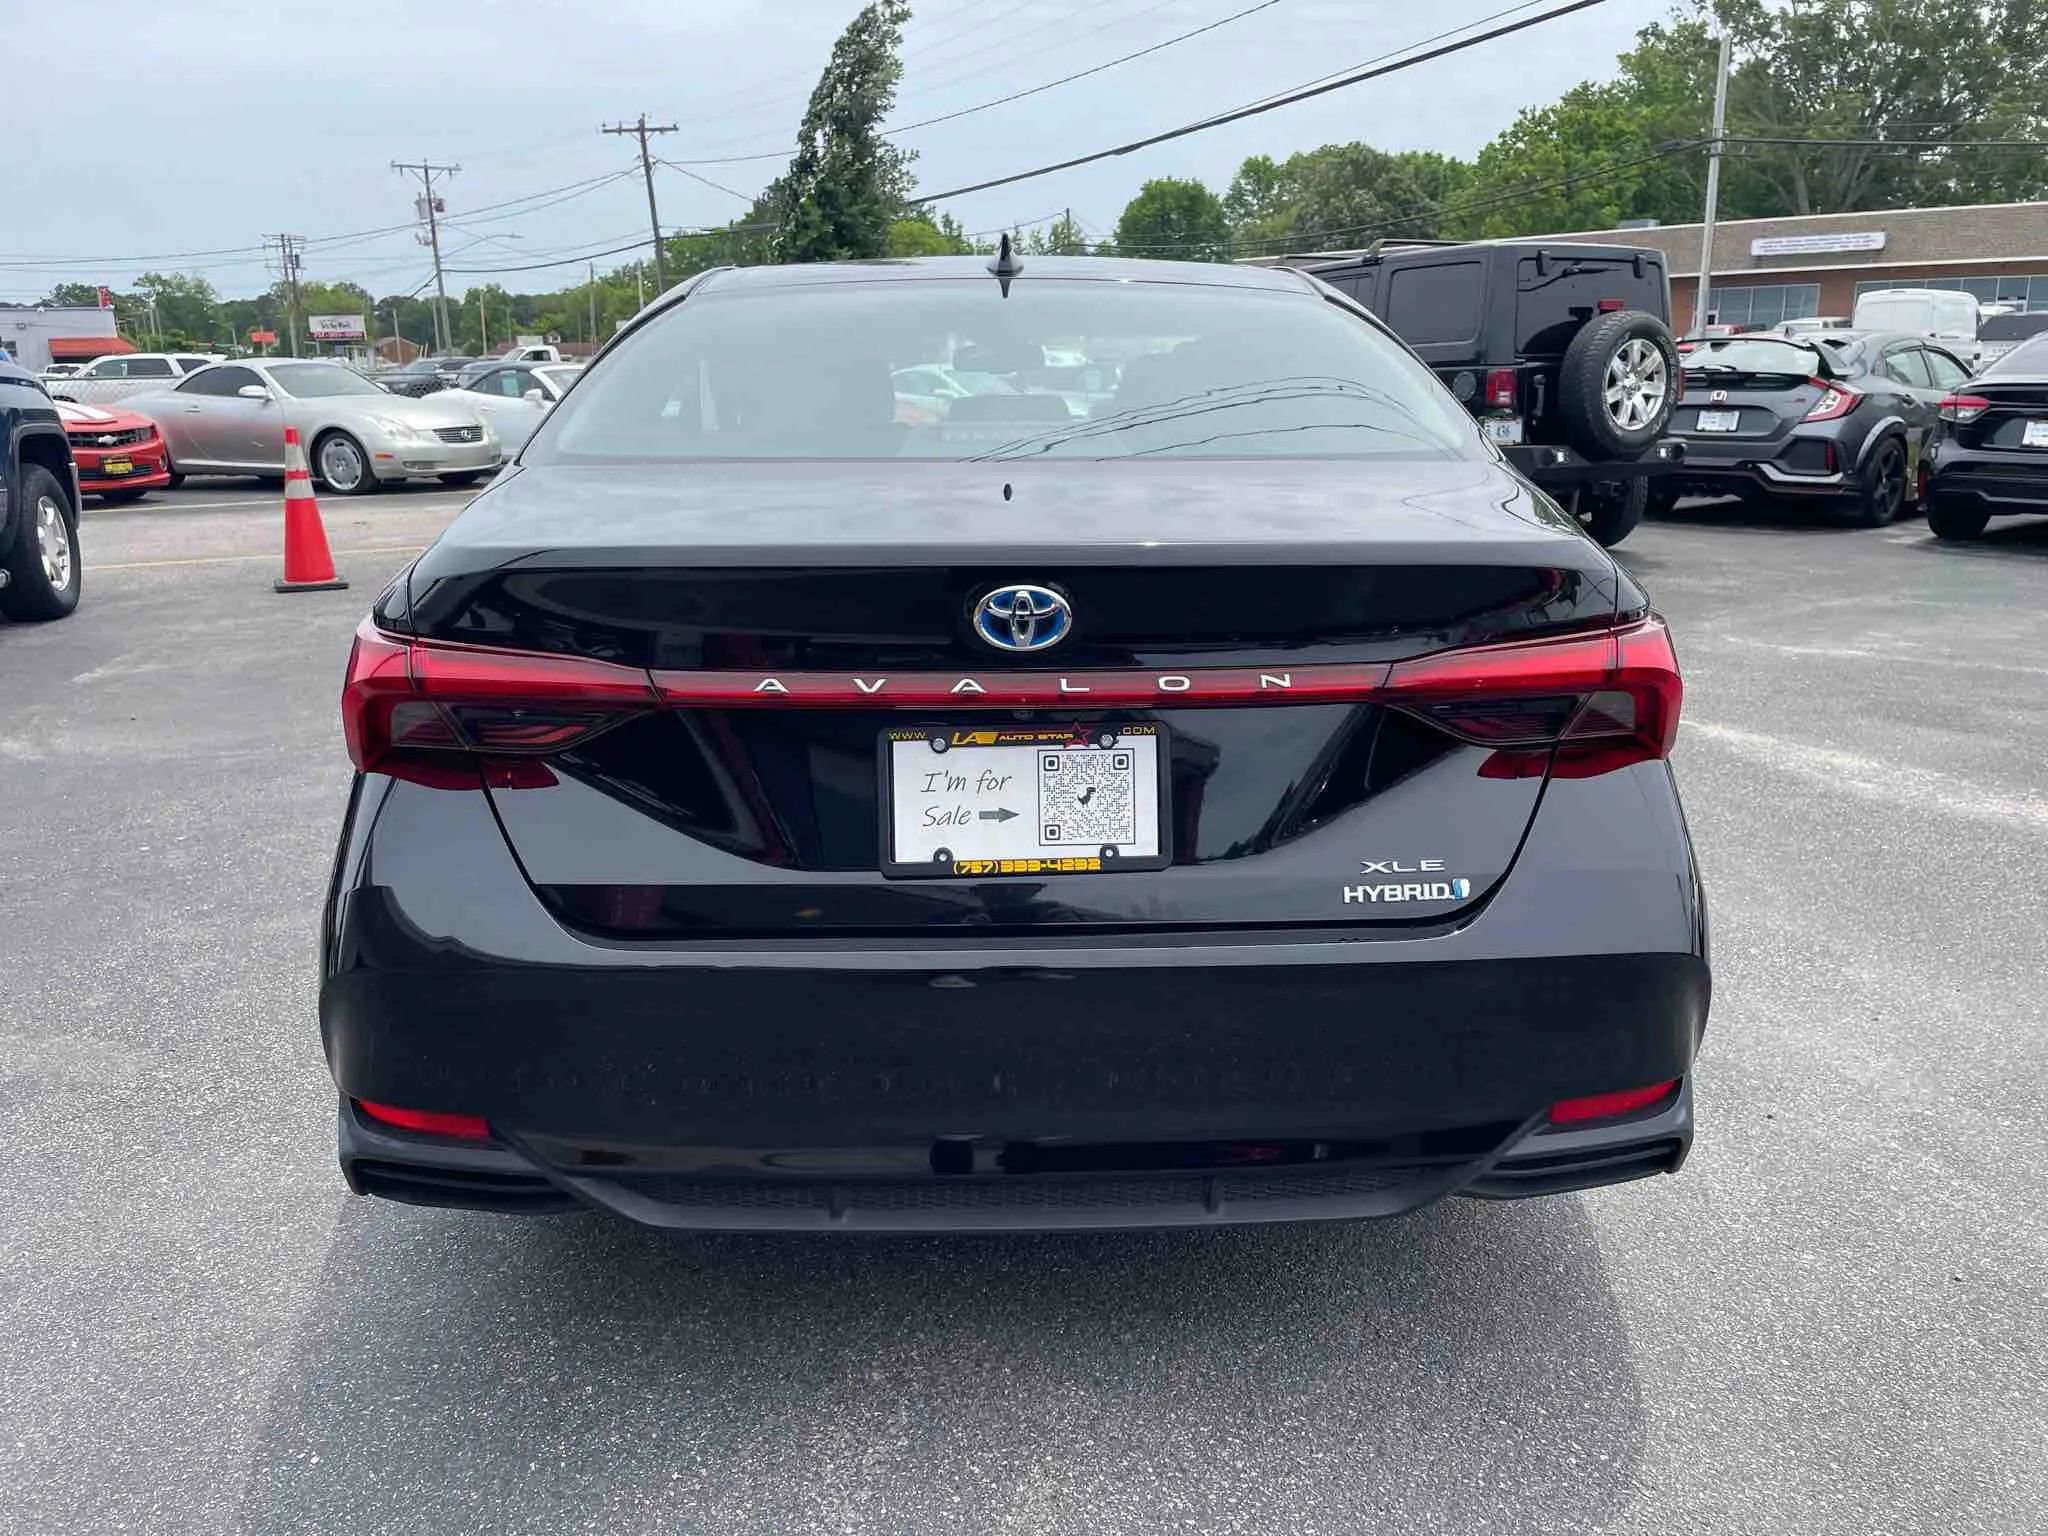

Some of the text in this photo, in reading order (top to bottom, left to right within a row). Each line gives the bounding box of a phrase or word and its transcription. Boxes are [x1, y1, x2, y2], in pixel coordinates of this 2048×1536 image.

[754, 673, 1291, 694] AVALON
[999, 733, 1033, 741] AUTO
[1038, 732, 1074, 740] STAR
[920, 768, 1013, 795] I'm for
[922, 805, 971, 827] Sale
[1360, 859, 1446, 874] XLE
[1343, 883, 1451, 903] HYBRID
